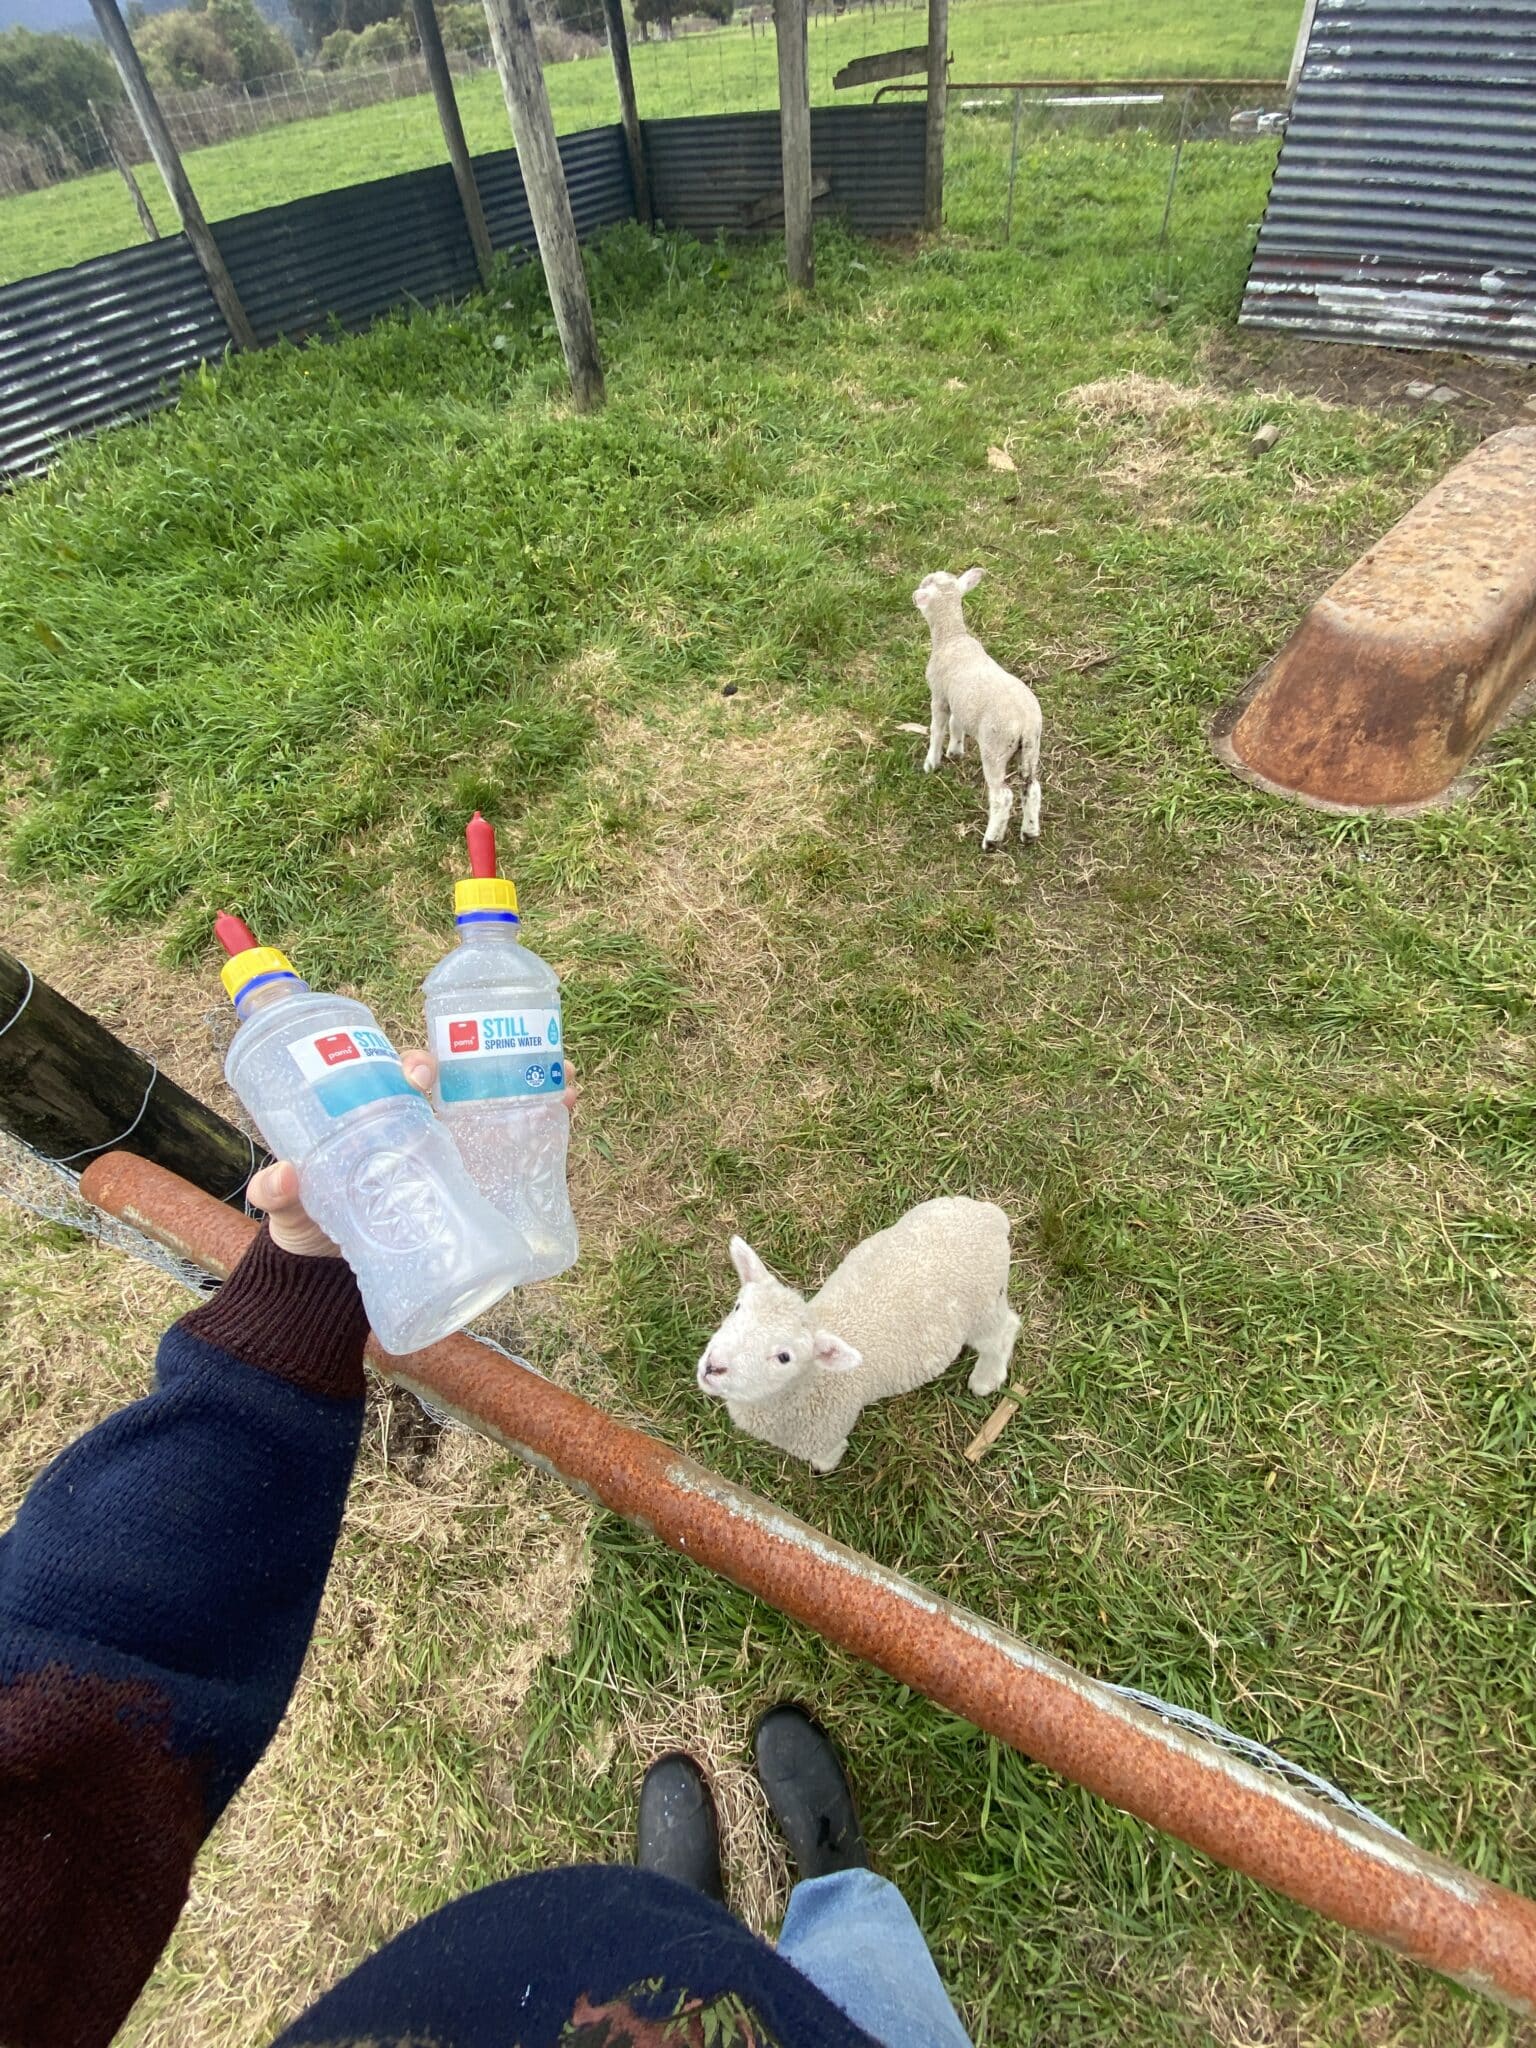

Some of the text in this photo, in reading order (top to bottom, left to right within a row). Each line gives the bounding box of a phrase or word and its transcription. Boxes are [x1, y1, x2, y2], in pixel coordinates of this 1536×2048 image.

[483, 1016, 529, 1038] STILL
[485, 1036, 542, 1050] SPRING WATER
[328, 1046, 353, 1060] pams
